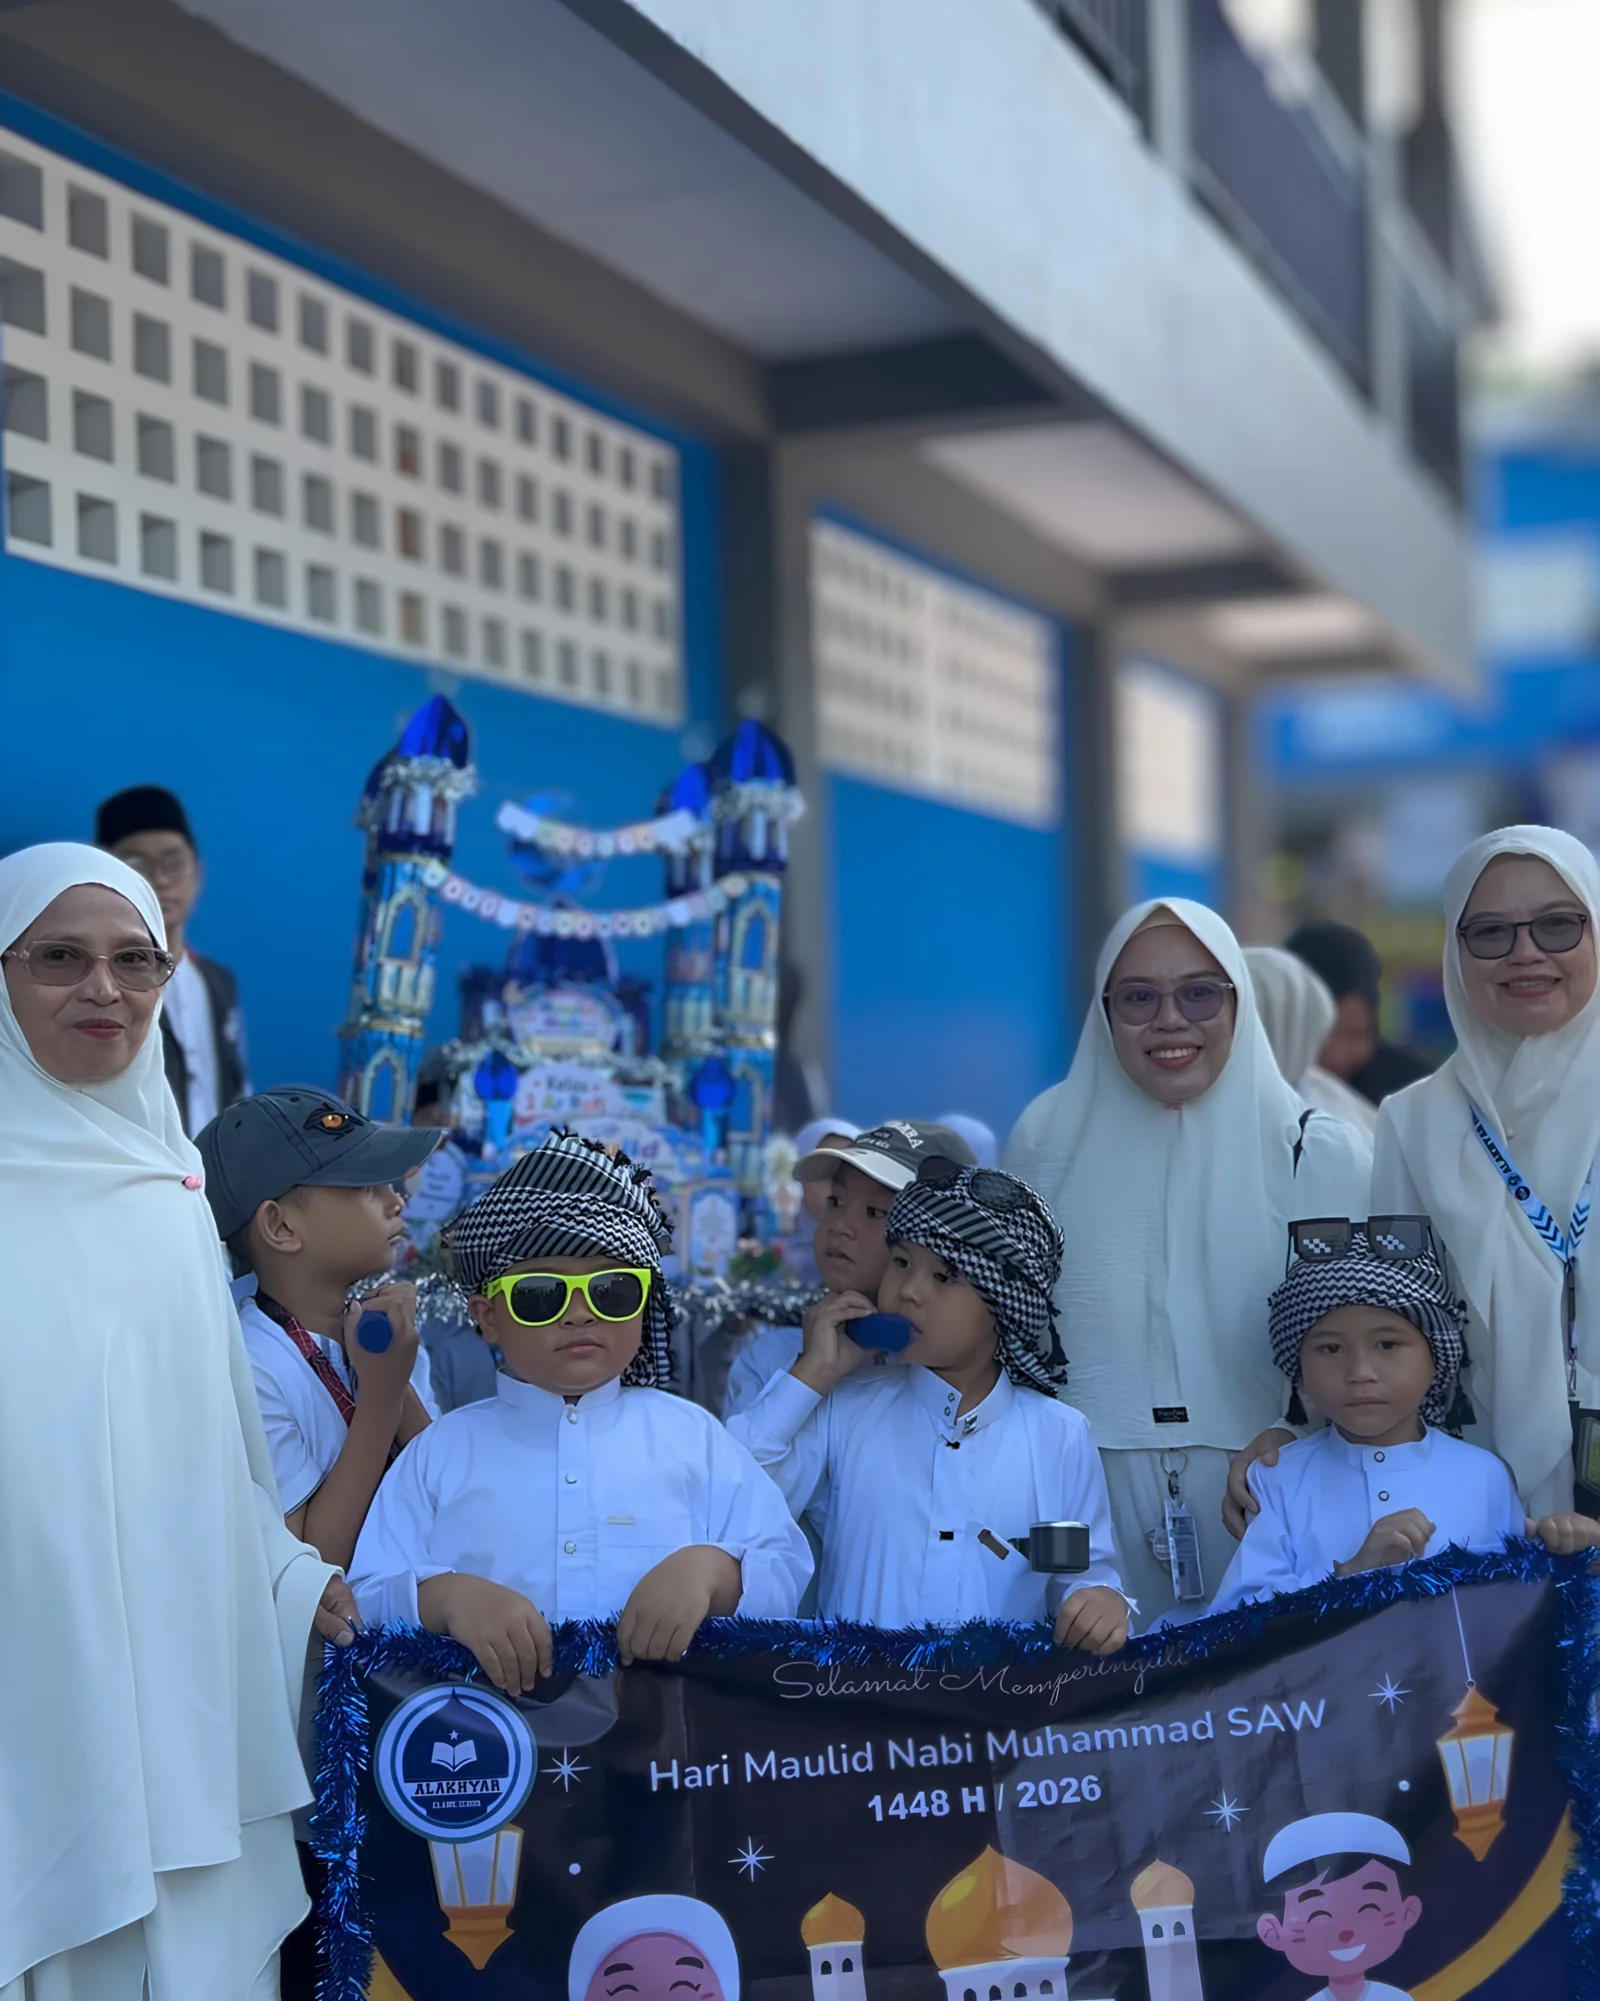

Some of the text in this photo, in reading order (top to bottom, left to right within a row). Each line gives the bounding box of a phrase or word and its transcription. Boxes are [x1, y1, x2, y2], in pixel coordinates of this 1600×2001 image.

[772, 1660, 930, 1699] Selamat
[649, 1698, 1326, 1793] Hari Maulid Nabi Muhammad SAW
[414, 1779, 501, 1795] ALAKHYAR
[868, 1789, 950, 1822] 1448
[961, 1786, 986, 1815] H
[1016, 1774, 1102, 1809] 2026
